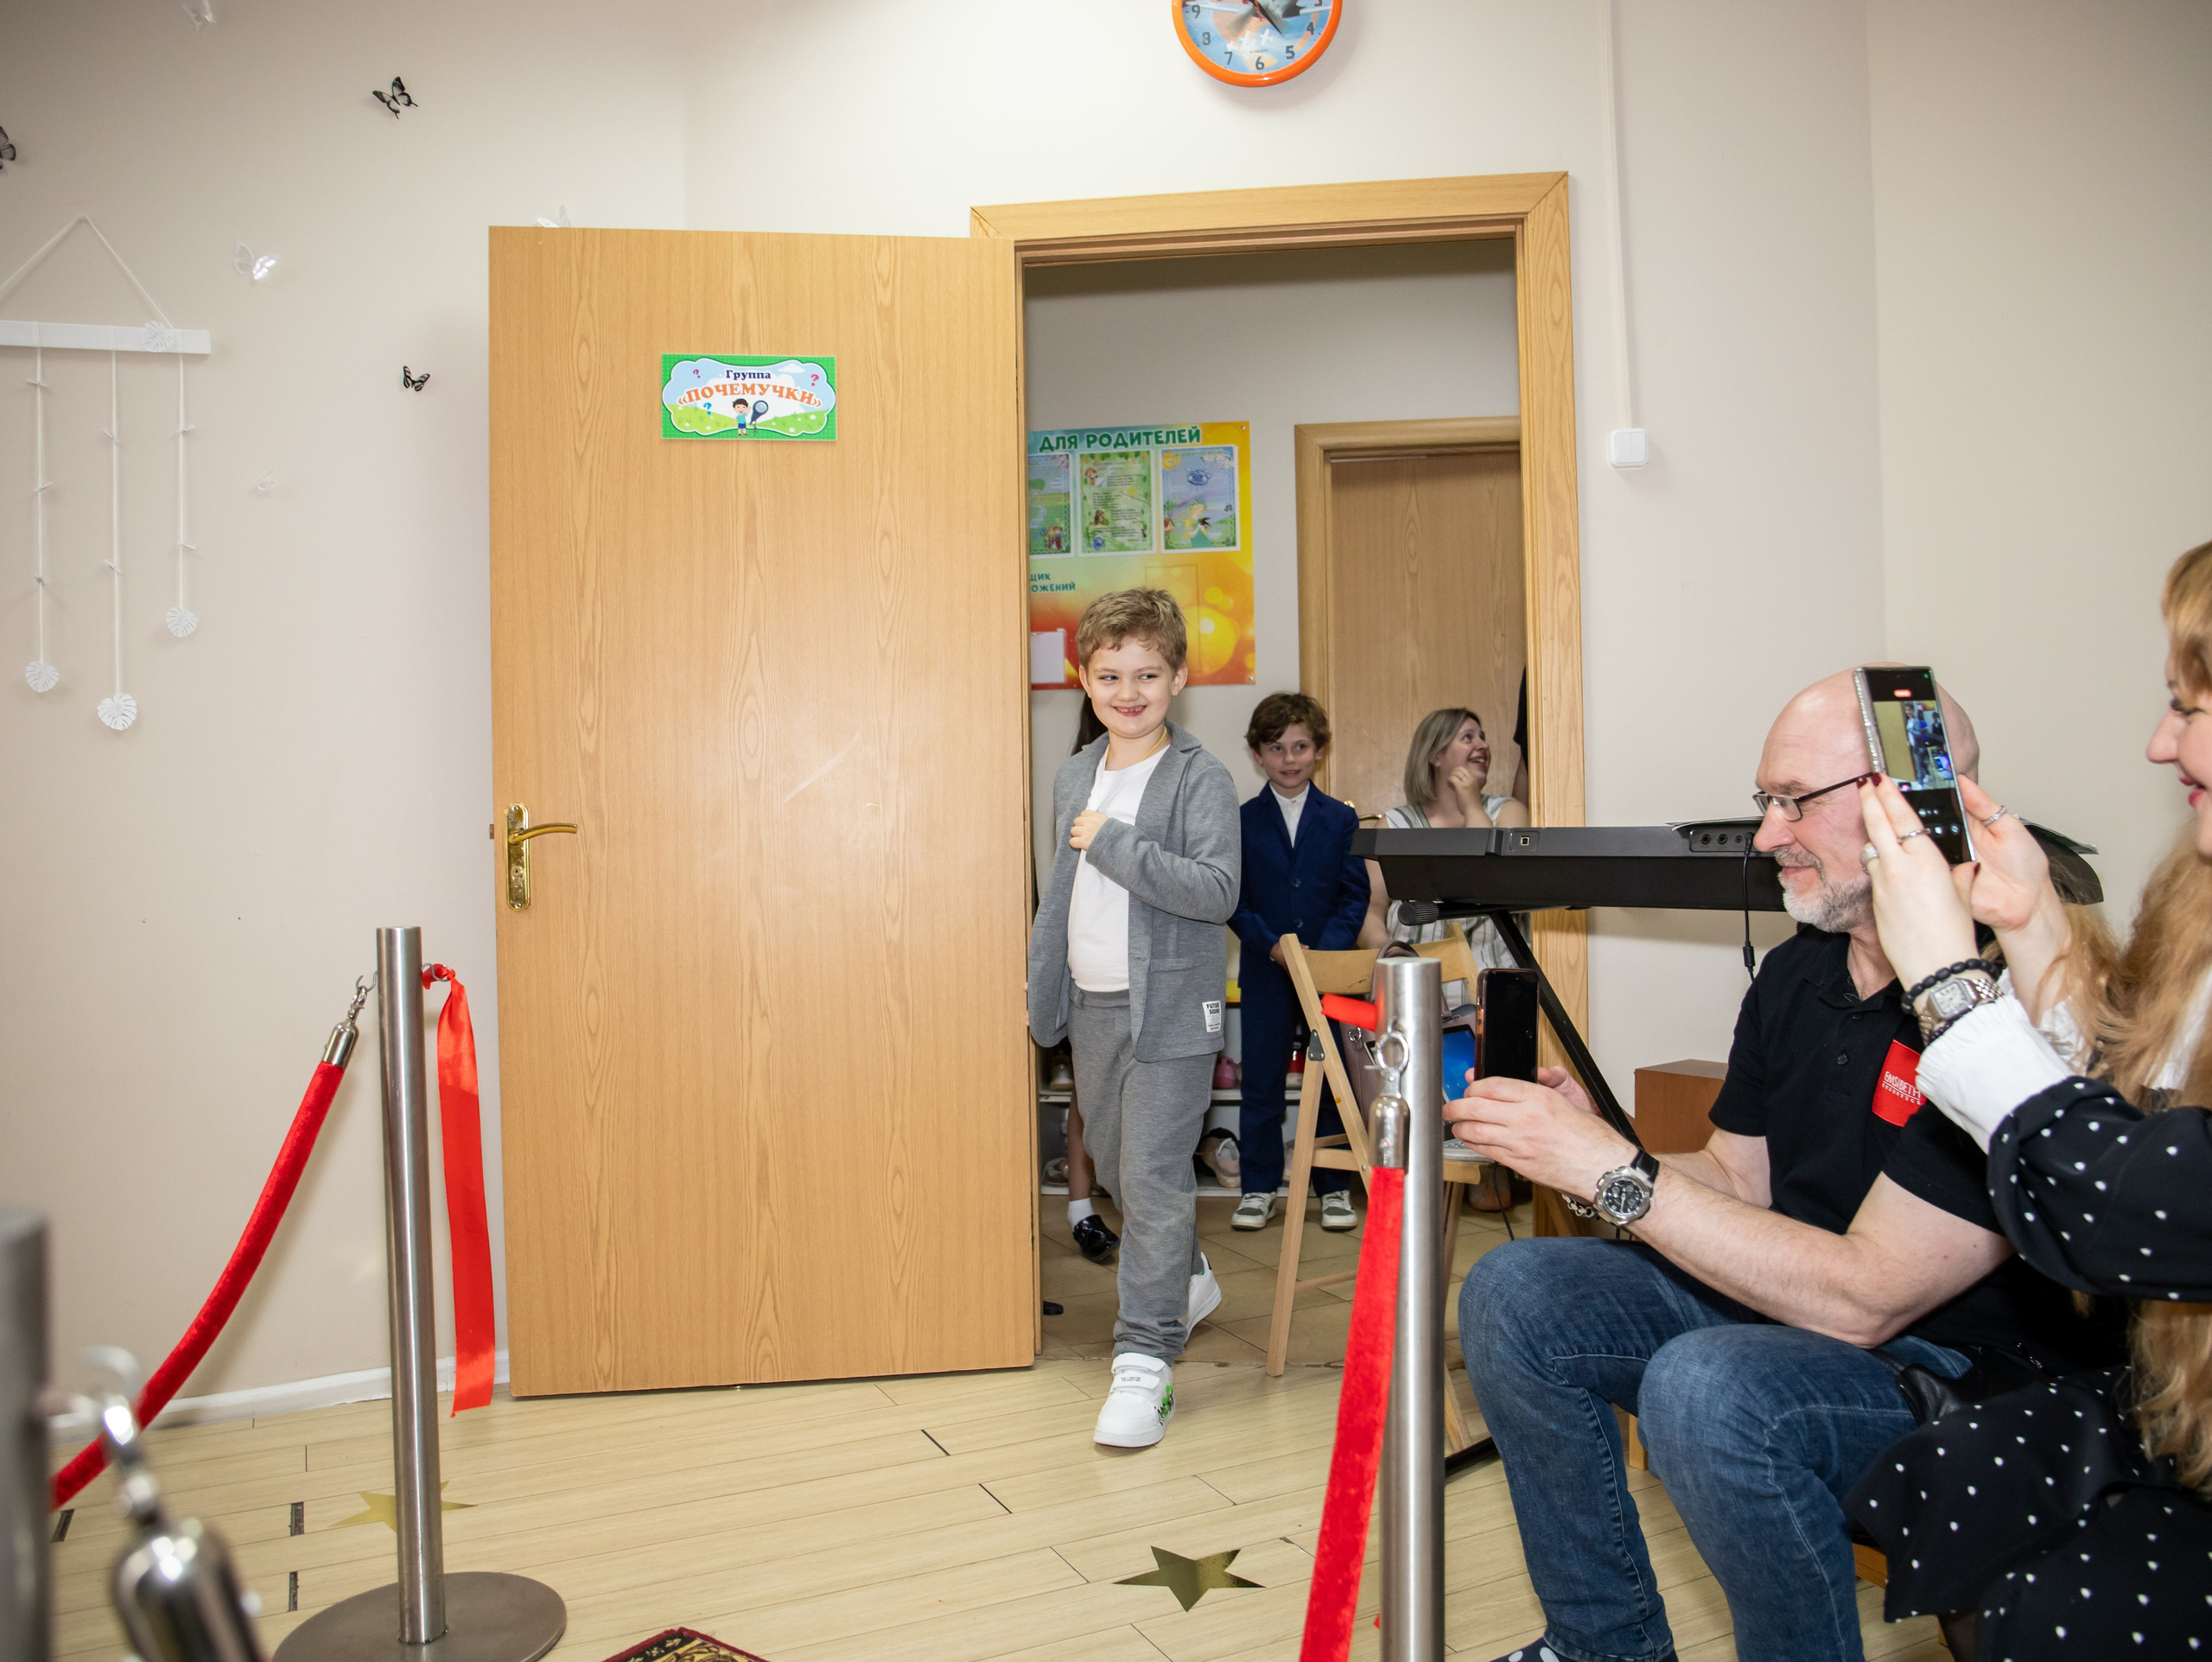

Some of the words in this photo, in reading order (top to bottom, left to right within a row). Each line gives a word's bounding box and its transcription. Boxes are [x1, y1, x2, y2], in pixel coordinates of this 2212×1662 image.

[1192, 4, 1200, 18] 9
[1306, 22, 1314, 35] 4
[1202, 32, 1211, 45] 8
[1224, 52, 1233, 65] 7
[1285, 45, 1295, 60] 5
[1255, 56, 1264, 70] 6
[726, 370, 772, 380] Группа
[677, 383, 822, 408] «ПОЧЕМУЧКИ»
[1039, 435, 1078, 453] ДЛЯ
[1086, 425, 1201, 448] РОДИТЕЛЕЙ
[1884, 1070, 1921, 1099] EMSIBETH
